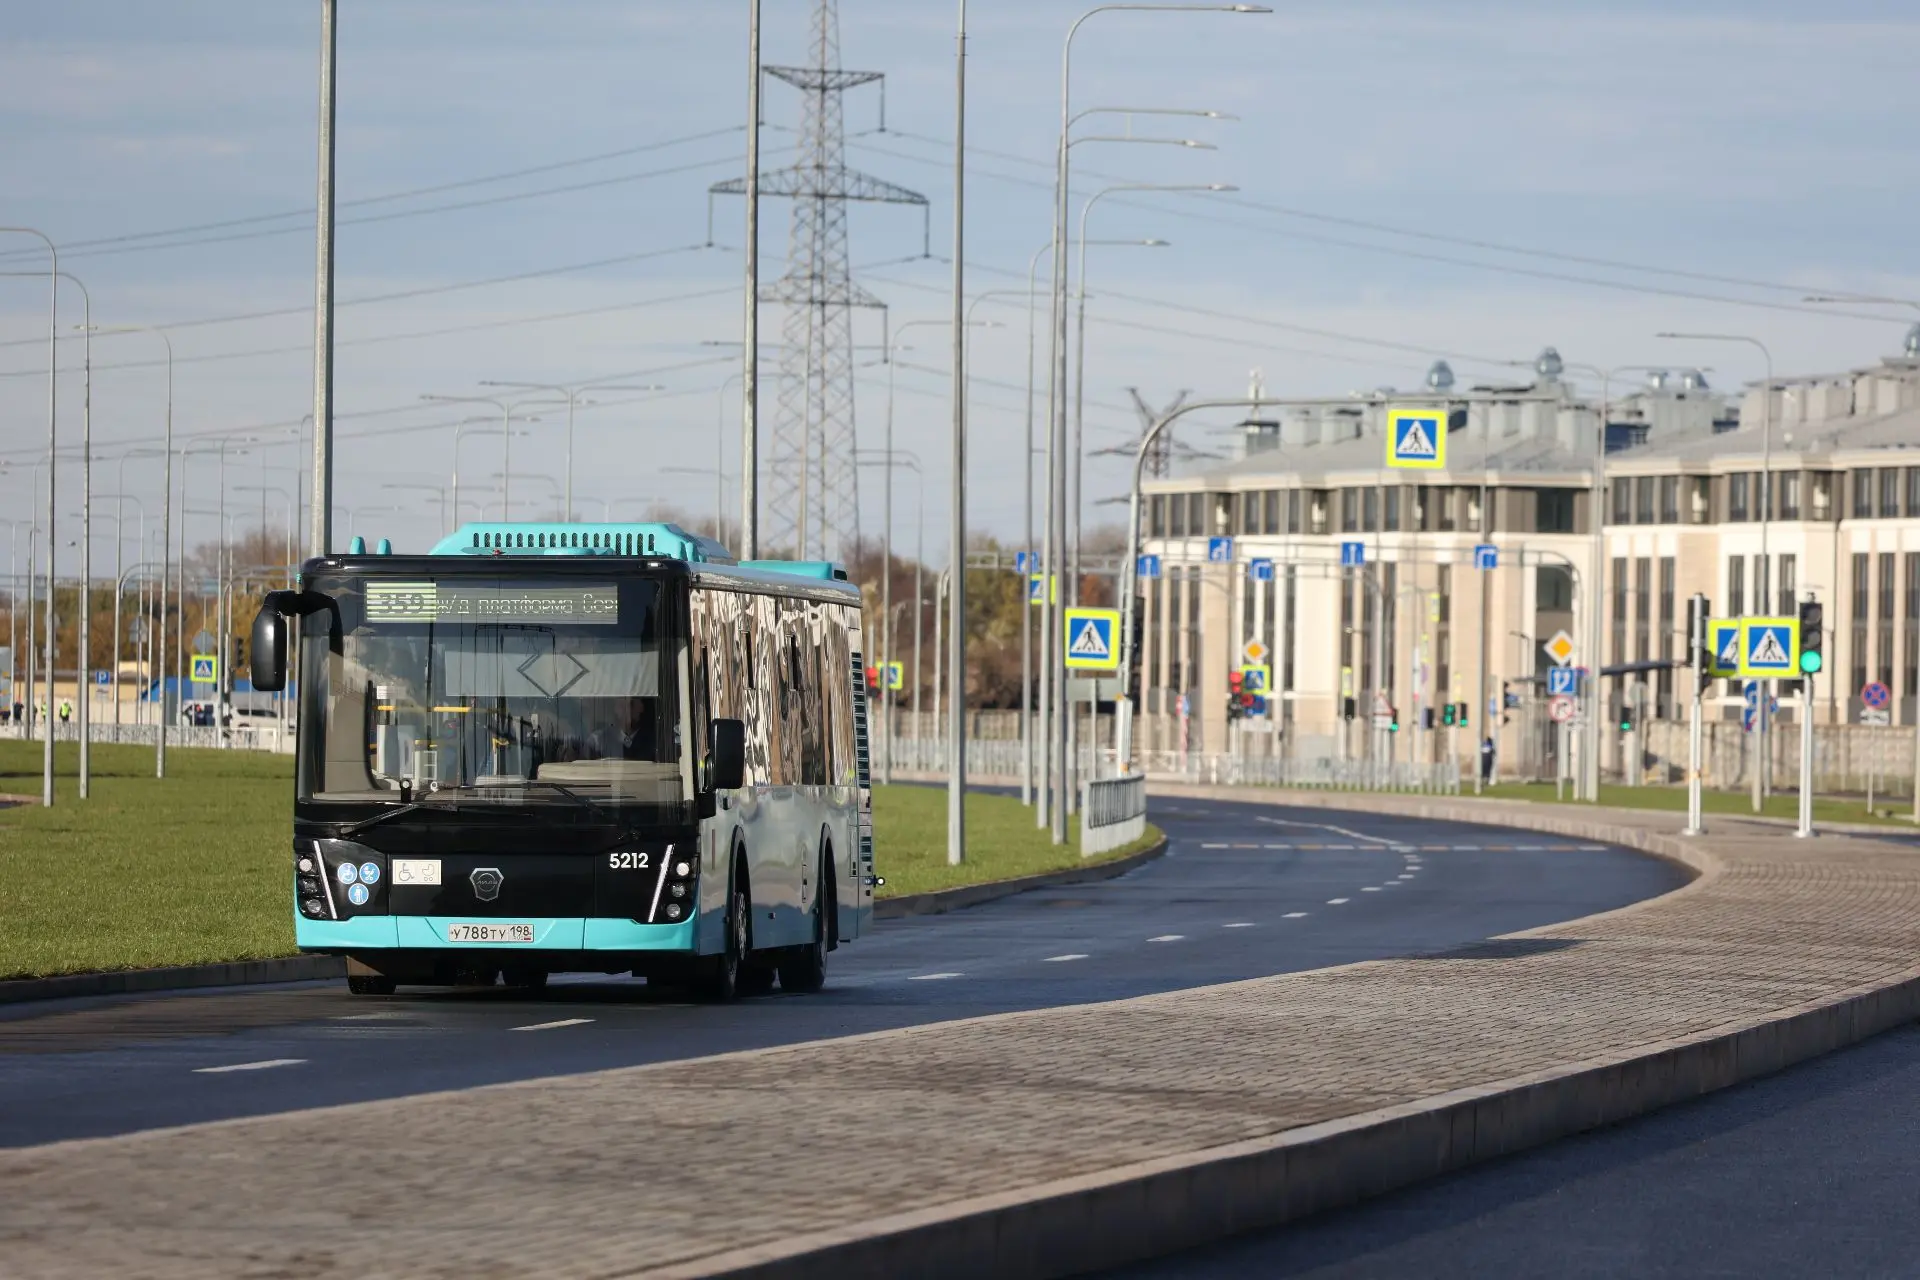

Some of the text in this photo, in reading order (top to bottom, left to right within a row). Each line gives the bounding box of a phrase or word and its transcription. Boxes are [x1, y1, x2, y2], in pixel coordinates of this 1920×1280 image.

[378, 592, 425, 614] 359
[478, 593, 573, 615] платформа
[609, 852, 649, 869] 5212
[510, 925, 530, 937] 198
